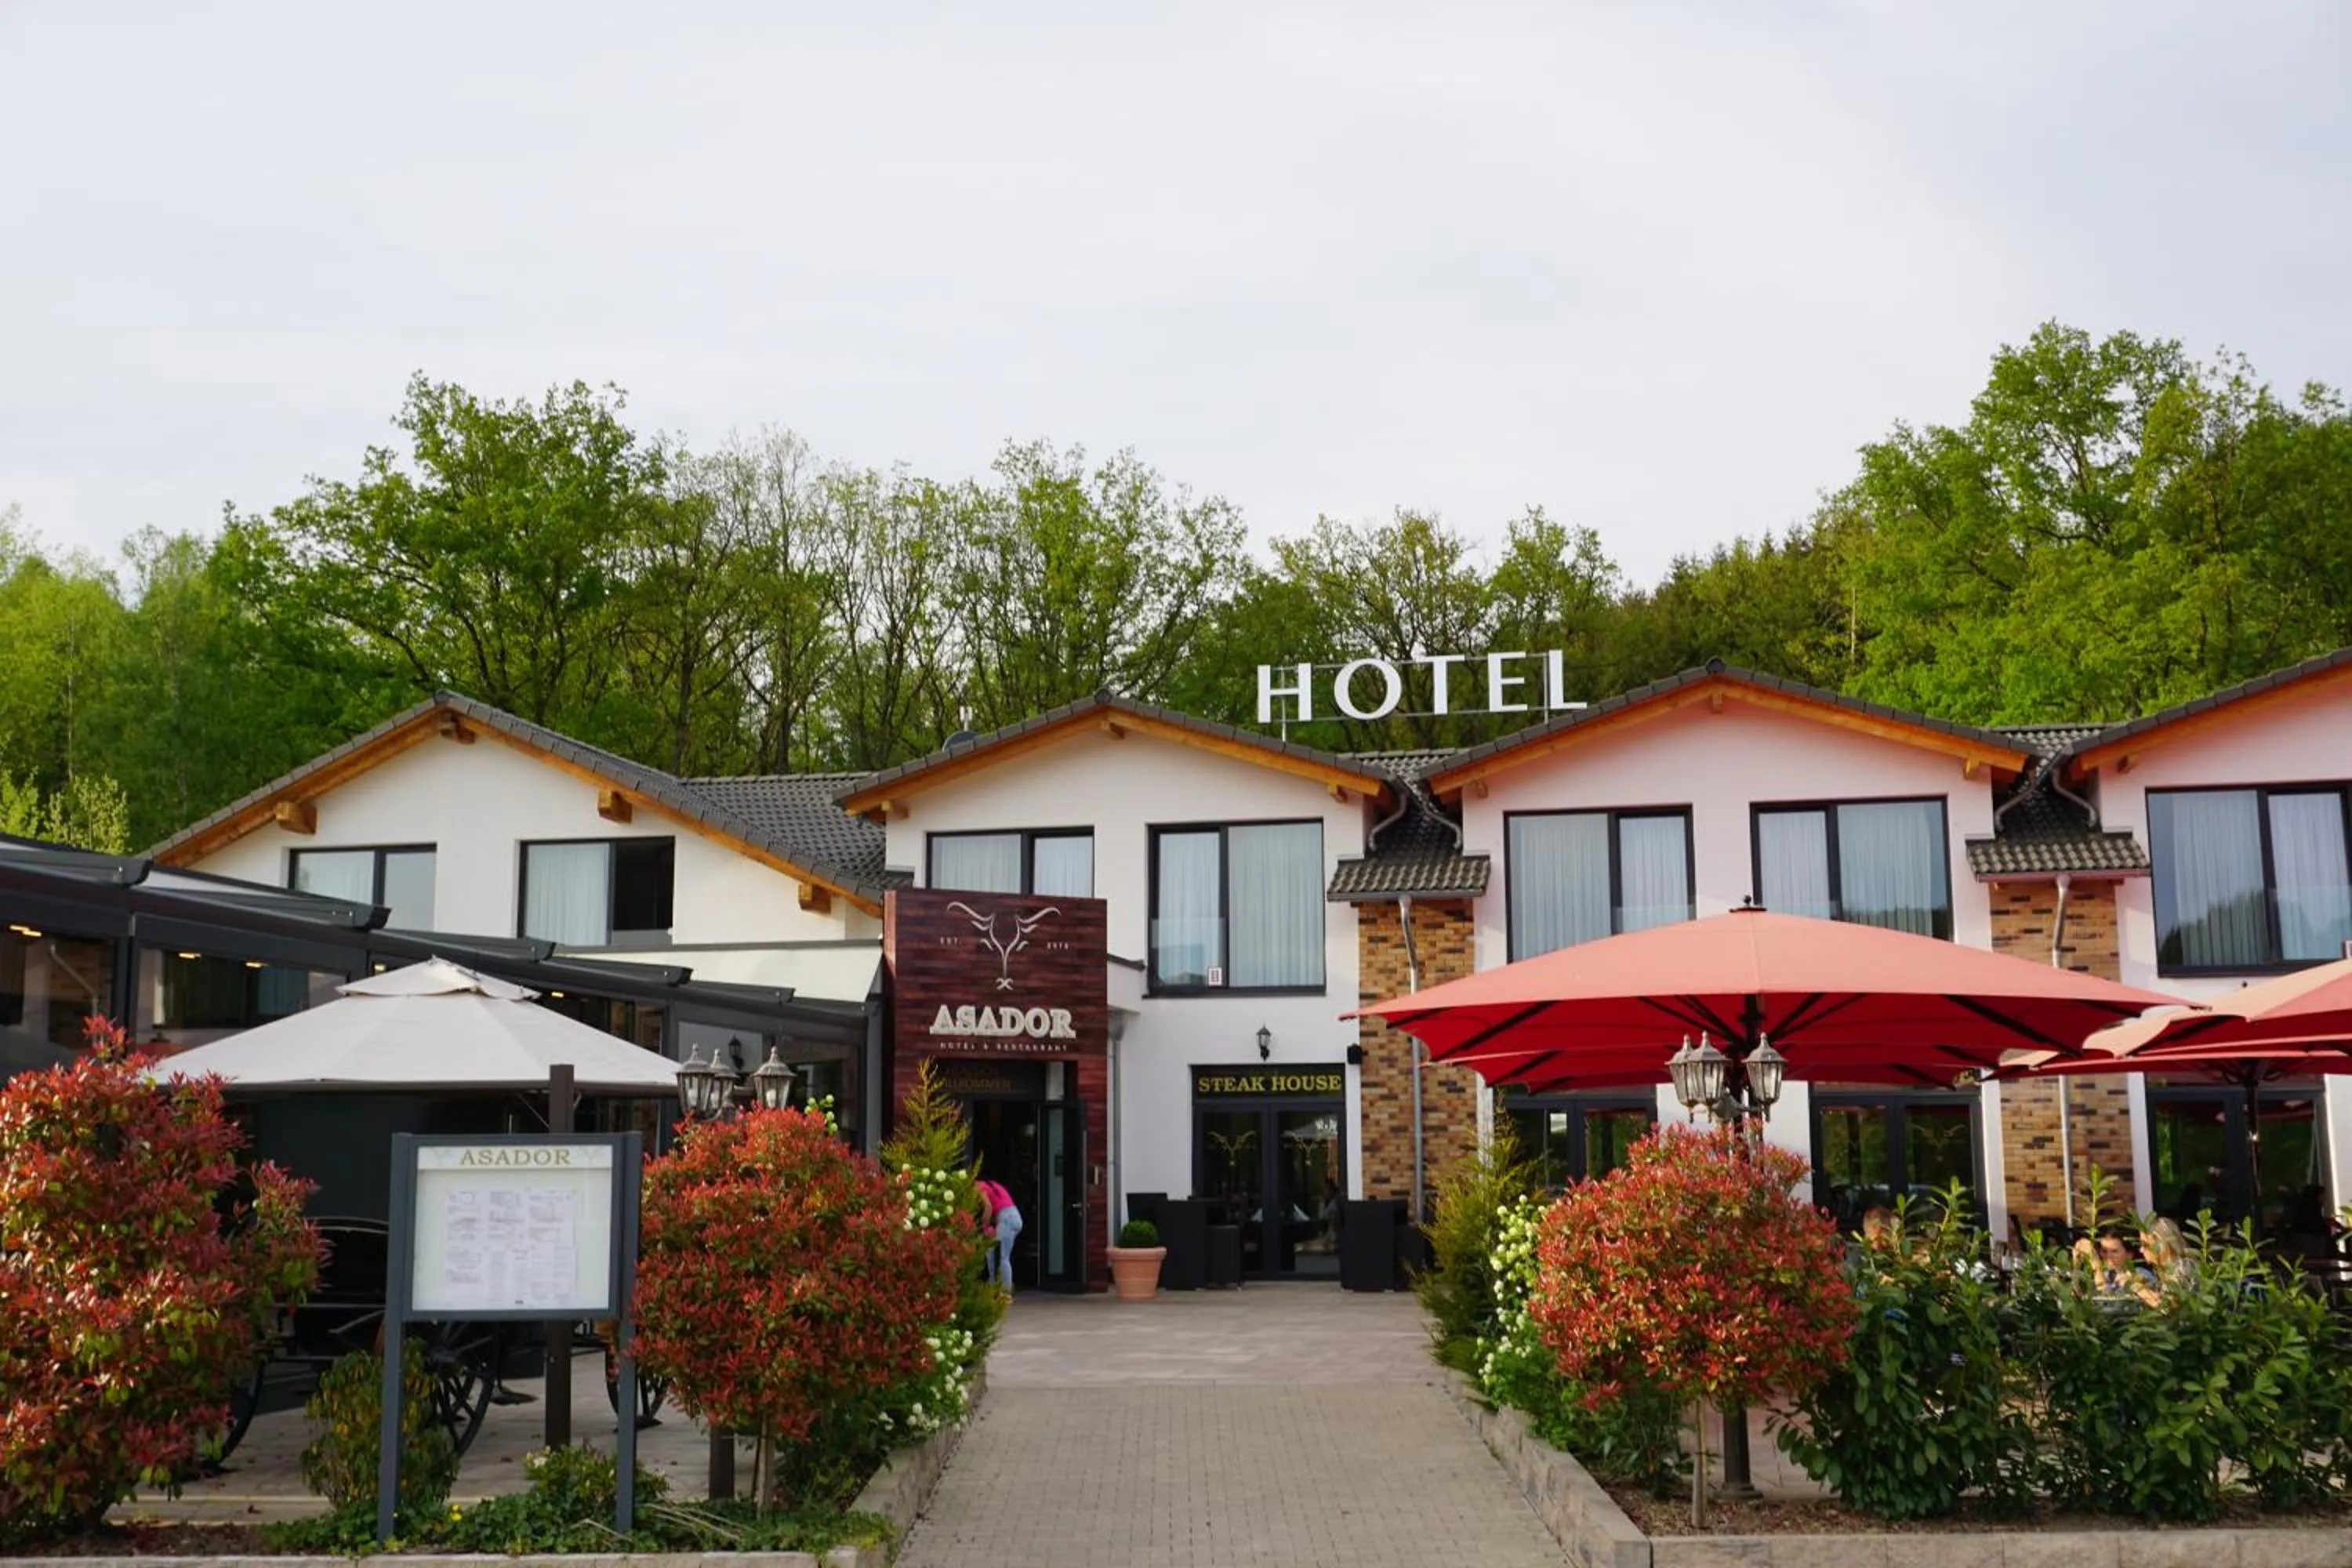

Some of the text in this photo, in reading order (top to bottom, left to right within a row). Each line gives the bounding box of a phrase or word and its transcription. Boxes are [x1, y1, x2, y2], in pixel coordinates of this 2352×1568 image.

[1258, 650, 1587, 724] HOTEL
[929, 1004, 1076, 1039] ASADOR
[940, 1041, 976, 1051] HOTEL
[996, 1043, 1068, 1052] RESTAURANT
[1198, 1074, 1342, 1093] STEAK HOUSE
[459, 1148, 572, 1166] ASADOR
